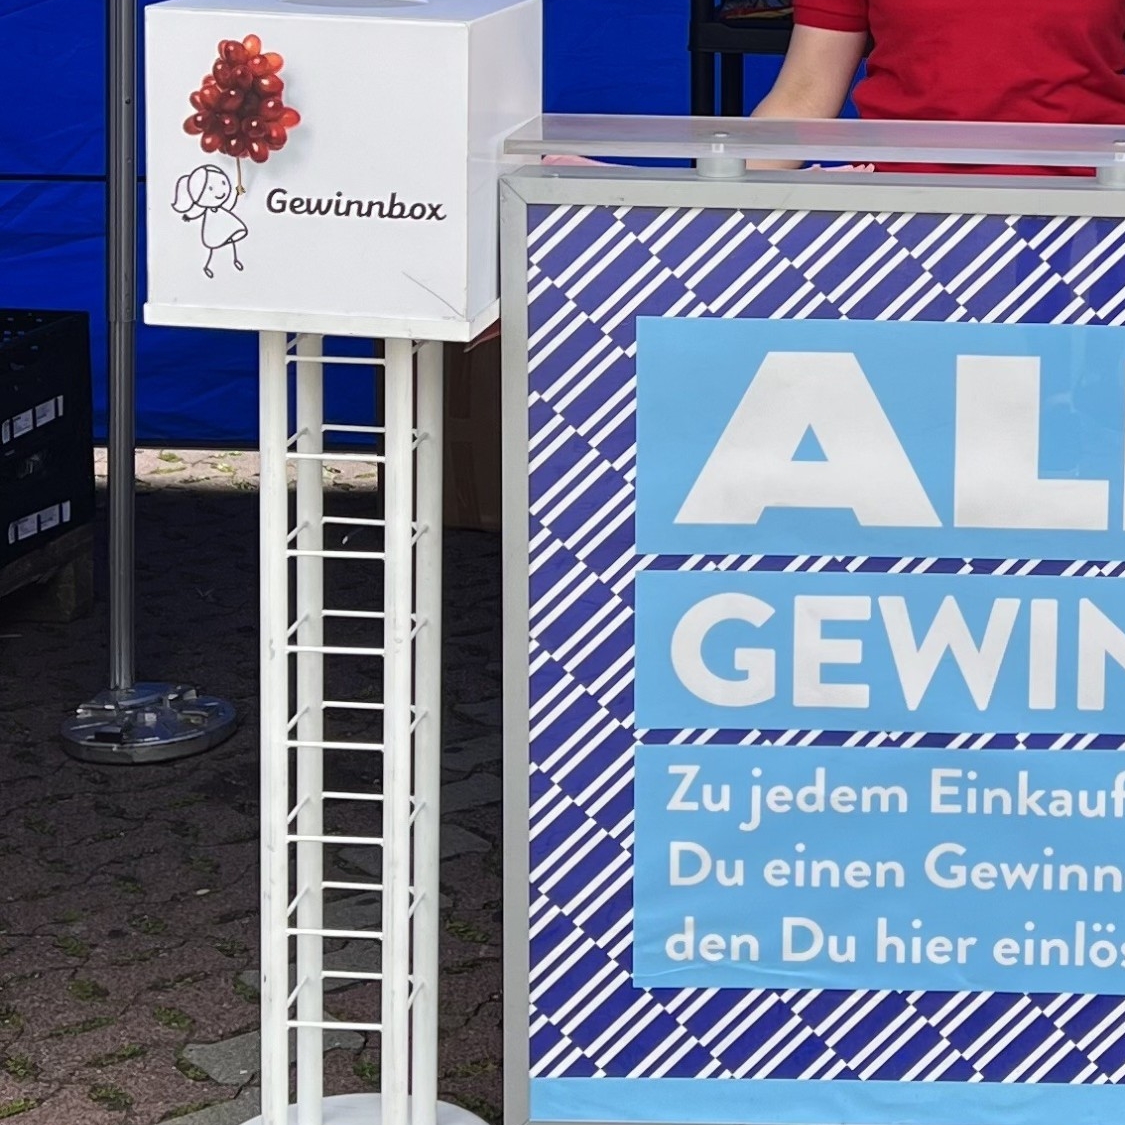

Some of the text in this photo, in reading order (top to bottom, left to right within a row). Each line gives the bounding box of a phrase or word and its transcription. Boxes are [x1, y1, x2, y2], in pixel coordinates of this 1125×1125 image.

[267, 188, 447, 221] Gewinnbox
[667, 765, 729, 811] Zu
[740, 768, 907, 831] jedem
[670, 842, 743, 886] Du
[764, 843, 904, 887] einen
[666, 917, 758, 961] den
[783, 917, 855, 962] Du
[878, 918, 976, 963] hier
